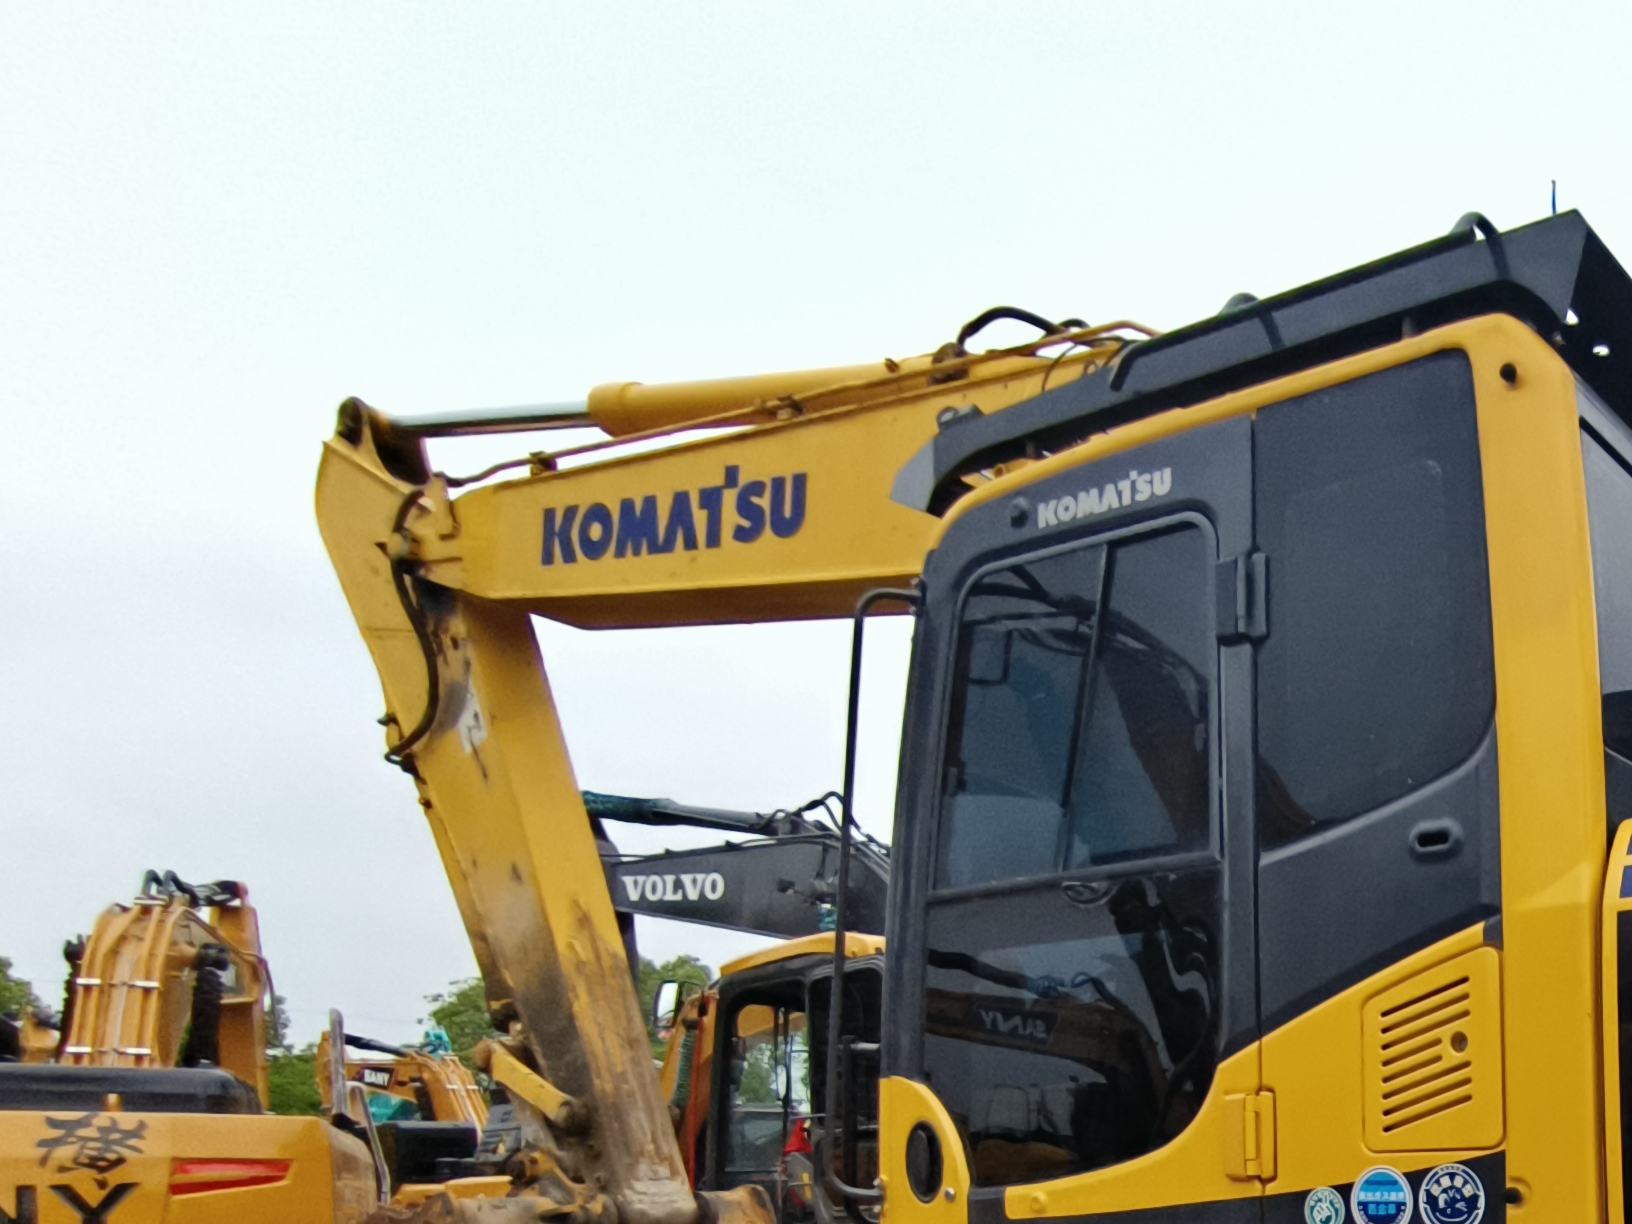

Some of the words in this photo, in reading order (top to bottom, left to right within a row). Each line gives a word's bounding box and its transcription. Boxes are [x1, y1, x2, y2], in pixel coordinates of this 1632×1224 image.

[541, 465, 807, 566] KOMATSU
[1037, 467, 1172, 529] KOMATSU
[621, 872, 725, 902] VOLVO
